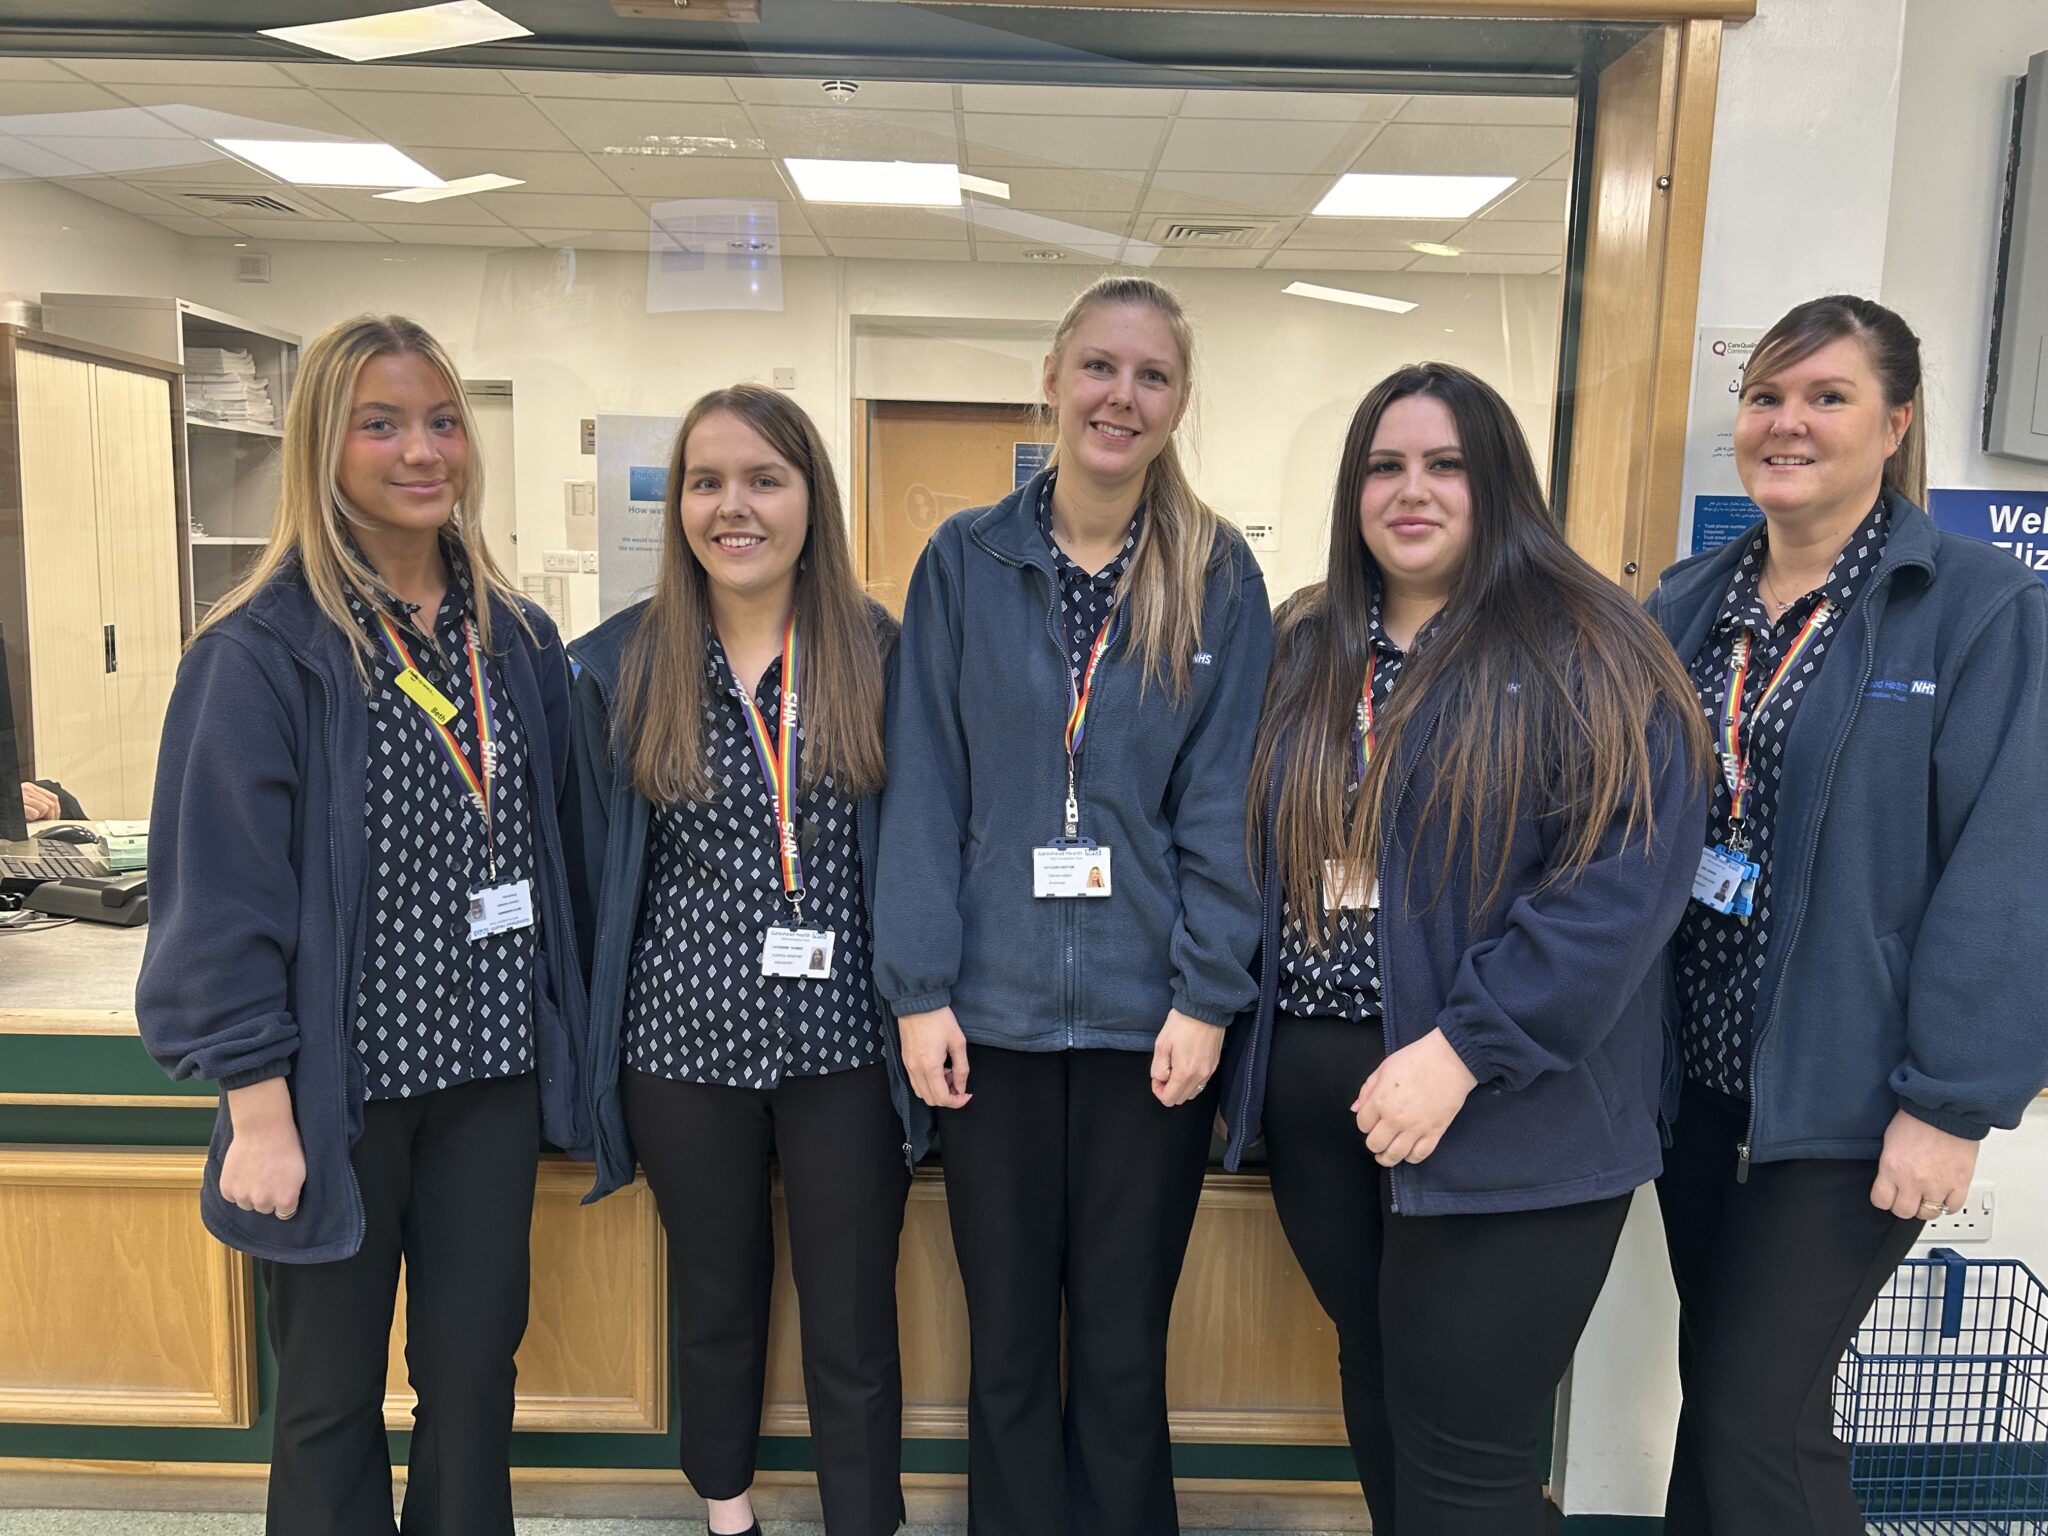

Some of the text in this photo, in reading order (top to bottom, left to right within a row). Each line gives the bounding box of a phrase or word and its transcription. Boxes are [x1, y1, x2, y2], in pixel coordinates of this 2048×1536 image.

[628, 505, 647, 514] How
[1992, 542, 2048, 571] liz
[1910, 680, 1937, 696] NHS
[431, 706, 446, 722] Beth
[783, 692, 798, 727] NHS
[482, 740, 497, 779] NHS
[782, 821, 798, 859] NHS
